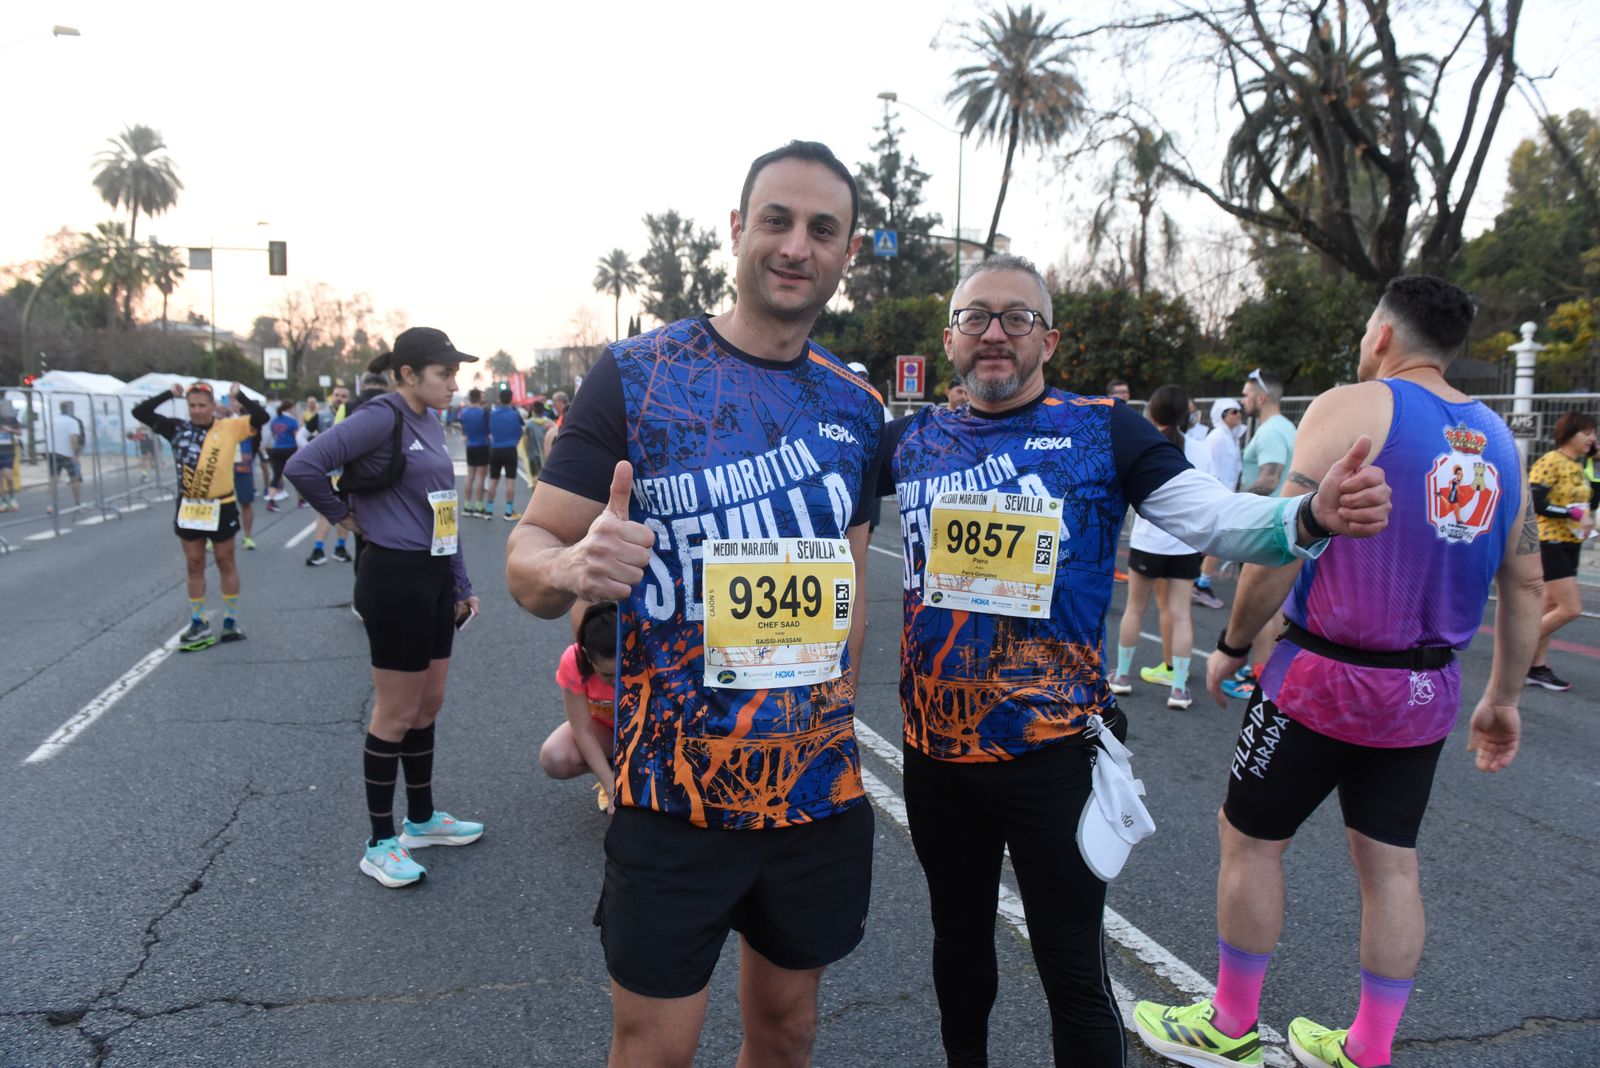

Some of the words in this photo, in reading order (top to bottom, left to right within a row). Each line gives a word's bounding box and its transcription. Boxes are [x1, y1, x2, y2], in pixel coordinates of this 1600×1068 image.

[818, 422, 859, 445] HOKA
[1024, 437, 1072, 450] HOKA
[633, 472, 698, 516] MEDIO
[704, 436, 821, 507] MARATÓN
[925, 452, 1019, 505] MARATÓN
[959, 492, 988, 505] MARATÓN
[1005, 494, 1043, 513] SEVILLA
[713, 542, 738, 557] MEDIO
[741, 540, 779, 556] MARATÓN
[797, 540, 836, 559] SEVILLA
[946, 519, 1026, 559] 9857
[708, 595, 716, 618] CAJÓN
[729, 575, 822, 620] 9349
[971, 598, 989, 606] HOKA
[757, 621, 779, 629] CHEF
[780, 620, 800, 628] SAAD
[774, 670, 795, 679] HOKA
